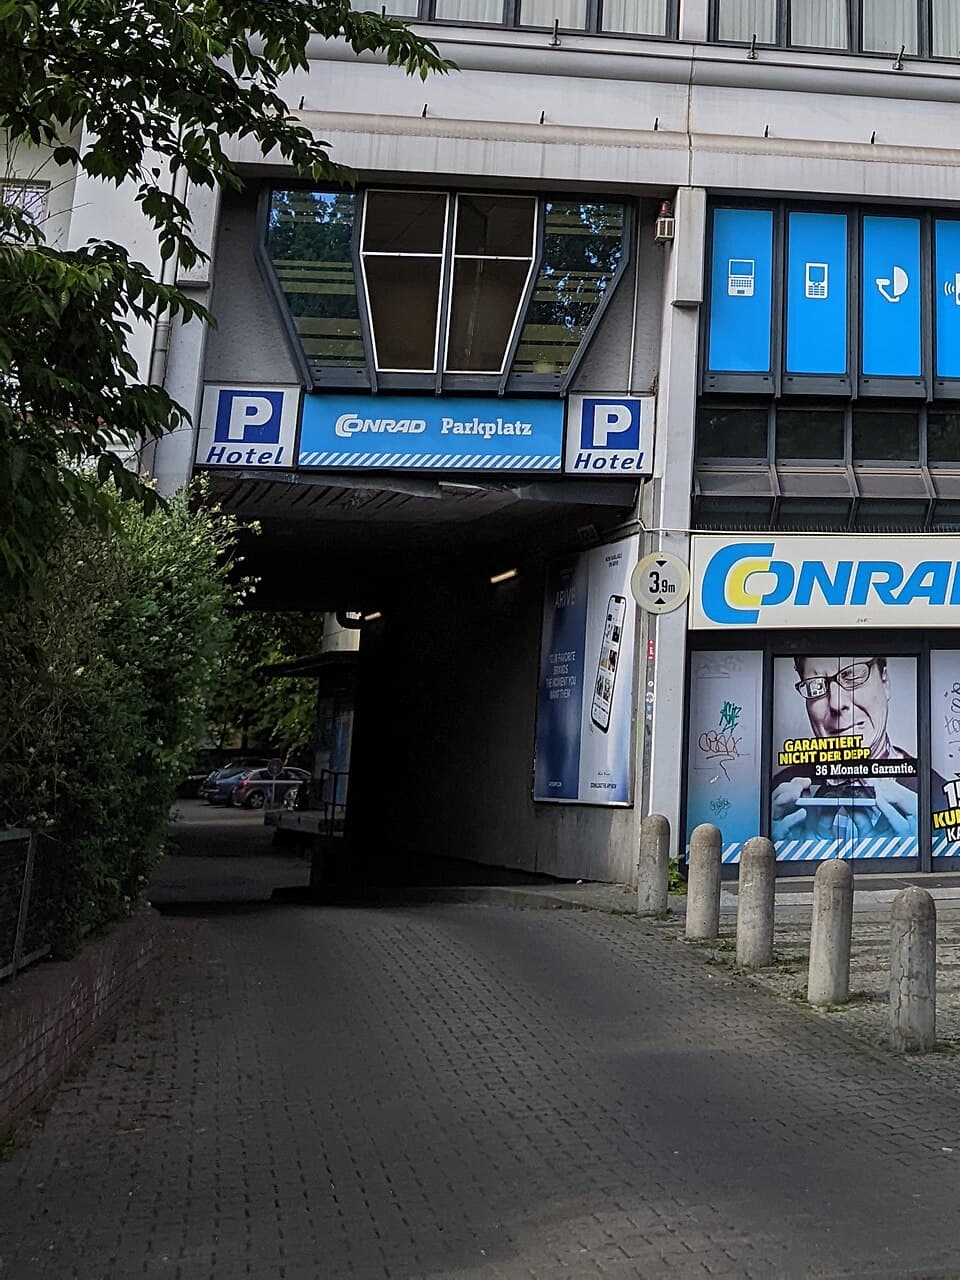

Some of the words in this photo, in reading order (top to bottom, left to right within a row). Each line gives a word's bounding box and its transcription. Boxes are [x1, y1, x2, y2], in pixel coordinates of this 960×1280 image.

[228, 396, 273, 440] P
[335, 413, 426, 438] CONRAD
[440, 417, 532, 439] Parkplatz
[593, 404, 632, 447] P
[206, 446, 285, 465] Hotel
[573, 452, 644, 470] Hotel
[784, 735, 863, 752] GARANTIERT
[779, 752, 818, 765] NICHT
[819, 751, 841, 762] DER
[843, 748, 871, 761] DEPP
[815, 764, 828, 776] 36
[830, 763, 869, 775] Monate
[871, 762, 917, 775] Garantie.
